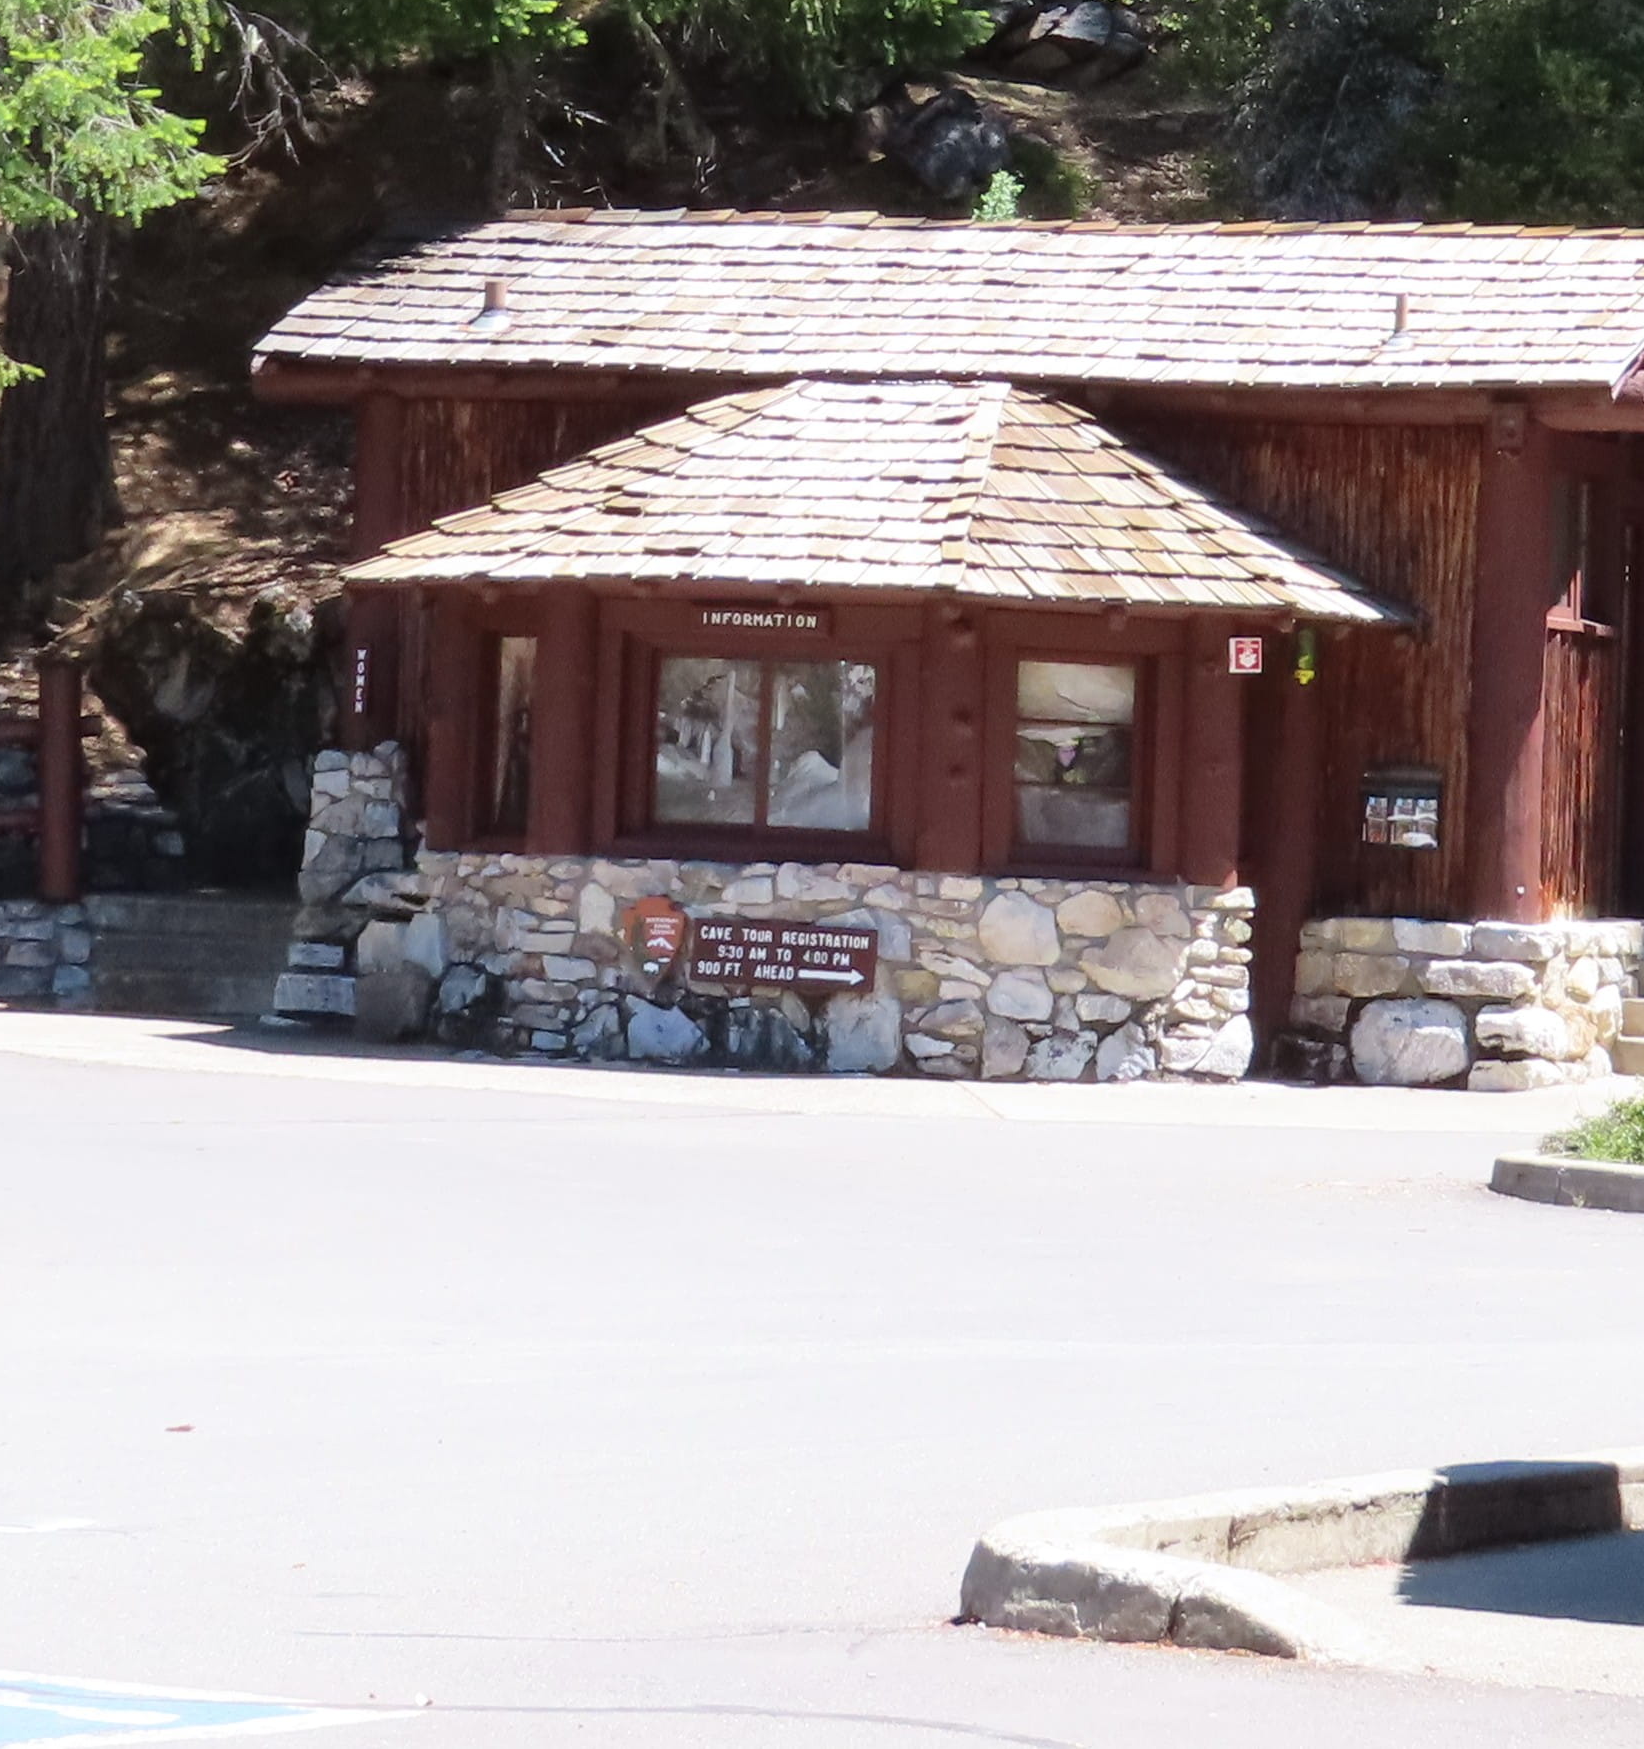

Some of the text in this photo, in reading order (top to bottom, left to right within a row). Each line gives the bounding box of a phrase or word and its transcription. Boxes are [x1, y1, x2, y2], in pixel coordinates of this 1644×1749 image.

[702, 611, 817, 628] INFORMATION
[355, 649, 367, 714] WOMEN
[700, 925, 869, 949] CAVE TOUR REGISTRATION
[718, 944, 743, 959] 9:30
[748, 947, 767, 961] AM
[776, 948, 792, 962] TO
[833, 953, 850, 966] PM
[697, 960, 721, 975] 900
[754, 964, 794, 980] AHEAD
